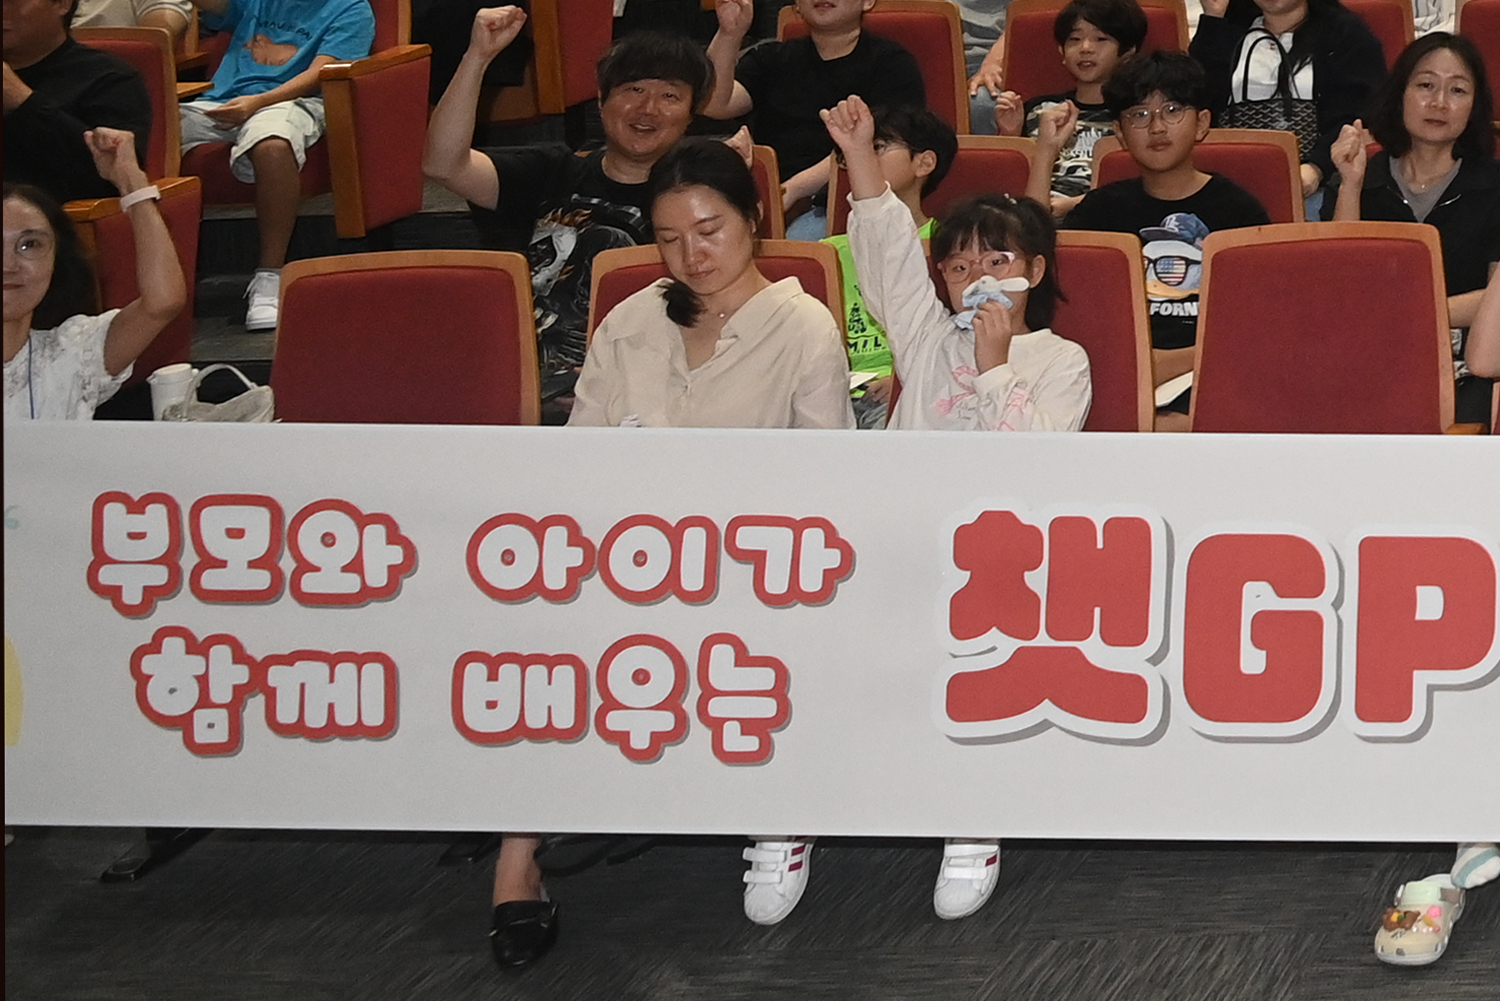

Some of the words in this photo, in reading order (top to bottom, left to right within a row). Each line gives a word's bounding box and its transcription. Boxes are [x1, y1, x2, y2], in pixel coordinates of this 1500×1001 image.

[86, 490, 418, 617] 부모와
[466, 512, 856, 608] 아이가
[130, 625, 399, 757] 함께
[451, 632, 792, 765] 배우는
